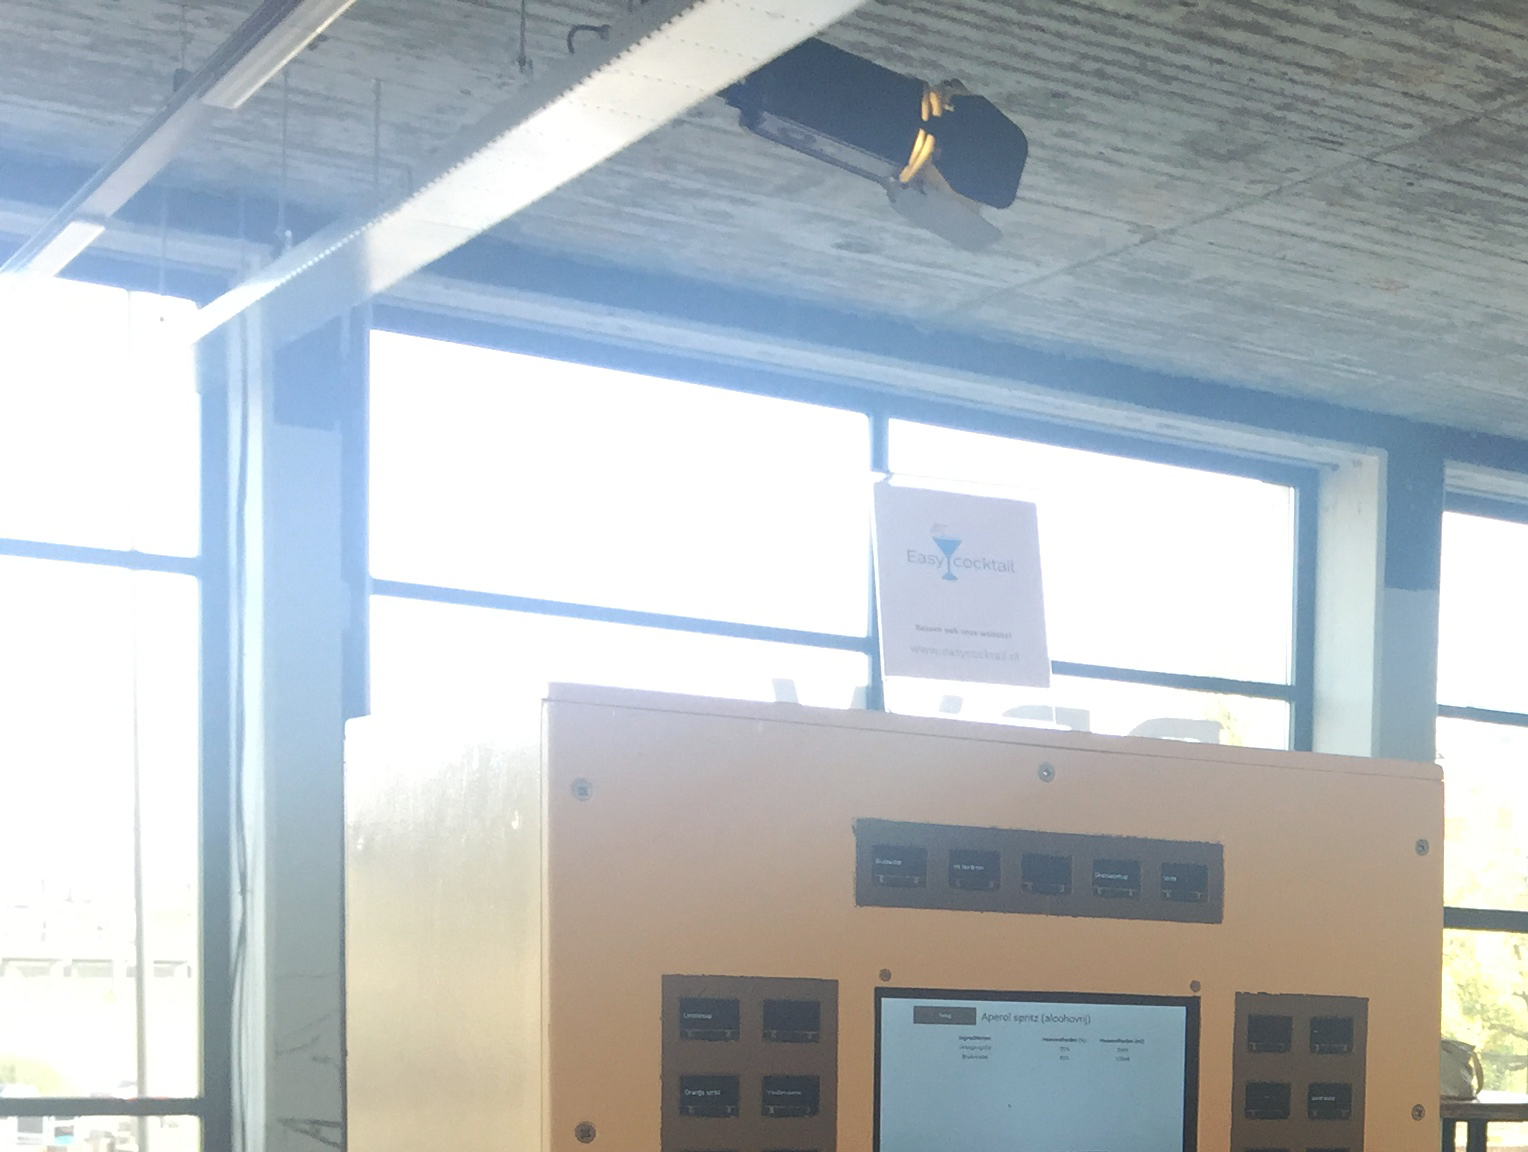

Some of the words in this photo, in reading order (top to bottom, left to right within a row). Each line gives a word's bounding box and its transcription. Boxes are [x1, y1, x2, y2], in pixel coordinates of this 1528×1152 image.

[907, 549, 944, 568] Easy
[953, 557, 1015, 574] cocktail
[981, 1012, 1011, 1023] Aperol
